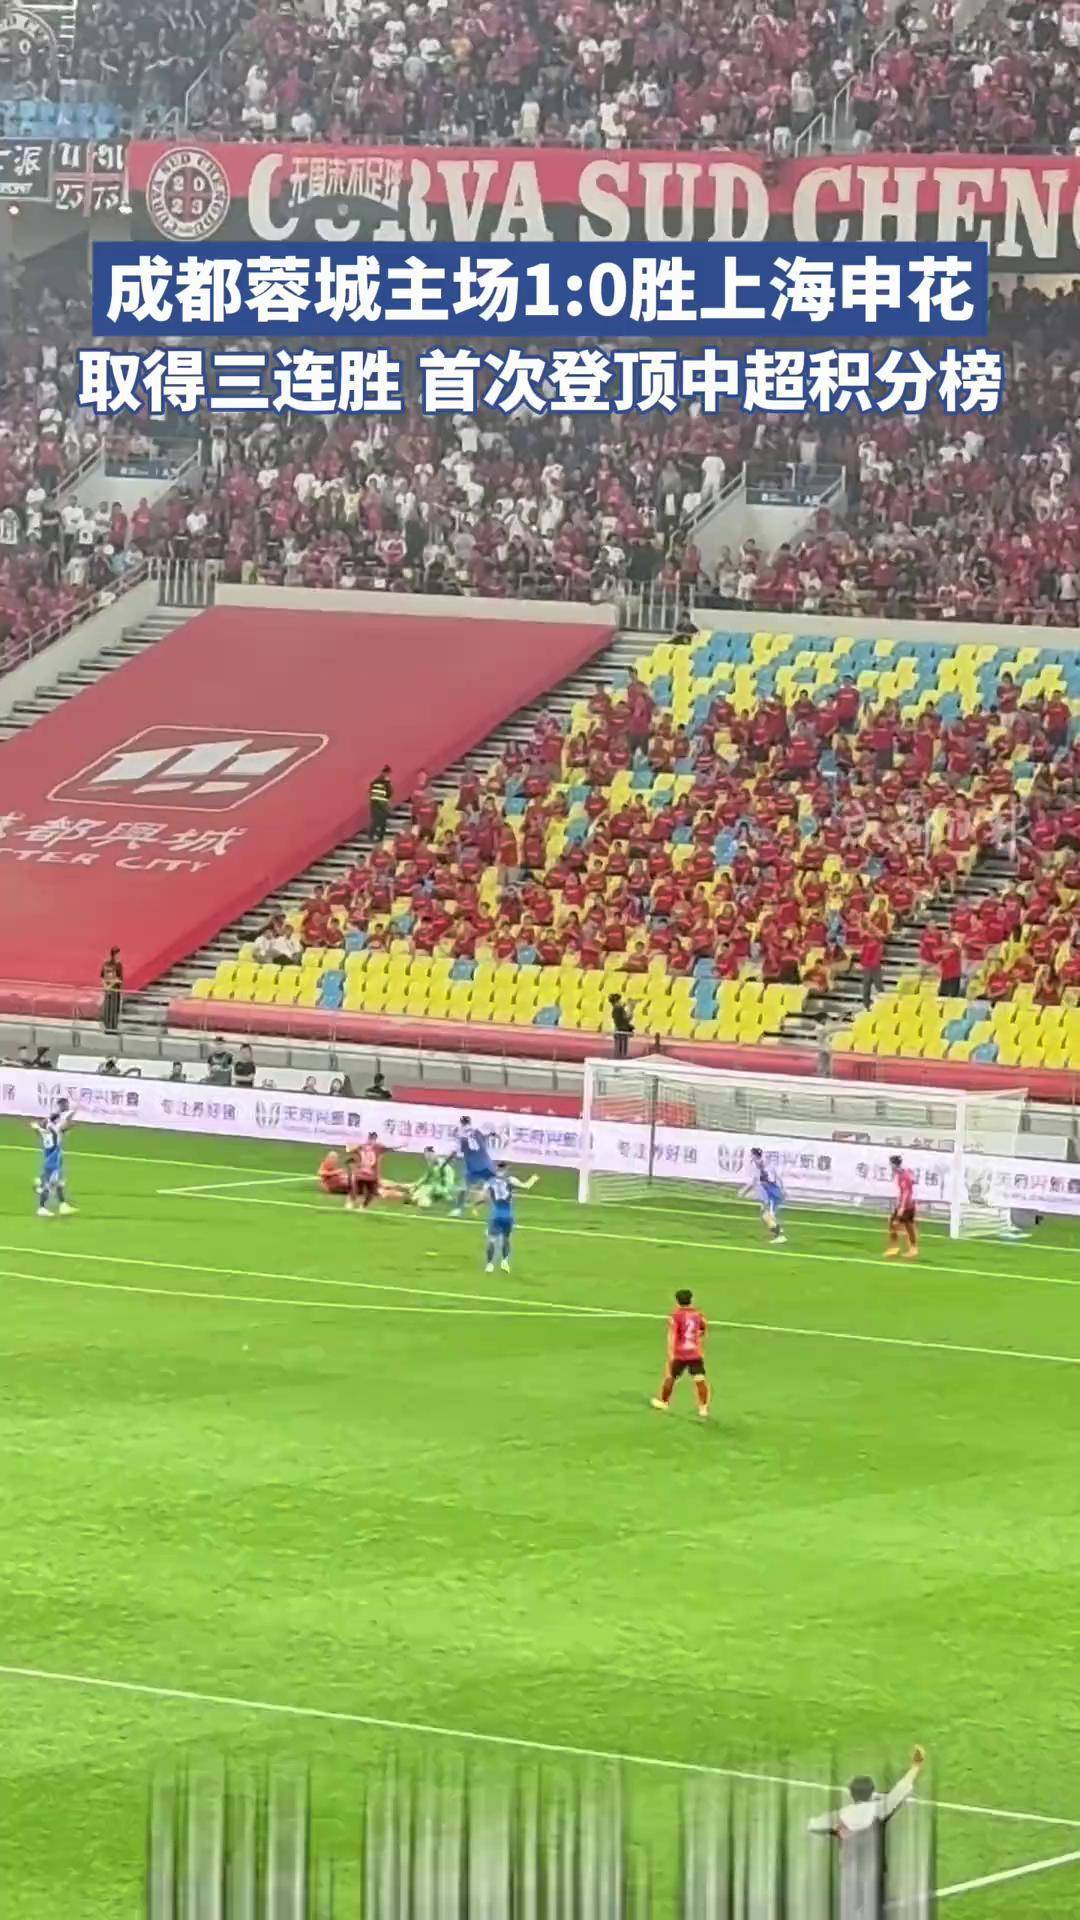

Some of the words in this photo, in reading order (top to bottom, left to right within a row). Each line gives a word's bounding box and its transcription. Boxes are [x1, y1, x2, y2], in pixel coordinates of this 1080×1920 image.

[578, 159, 770, 242] SUD
[792, 164, 1080, 258] CHEN
[115, 855, 211, 873] CITY
